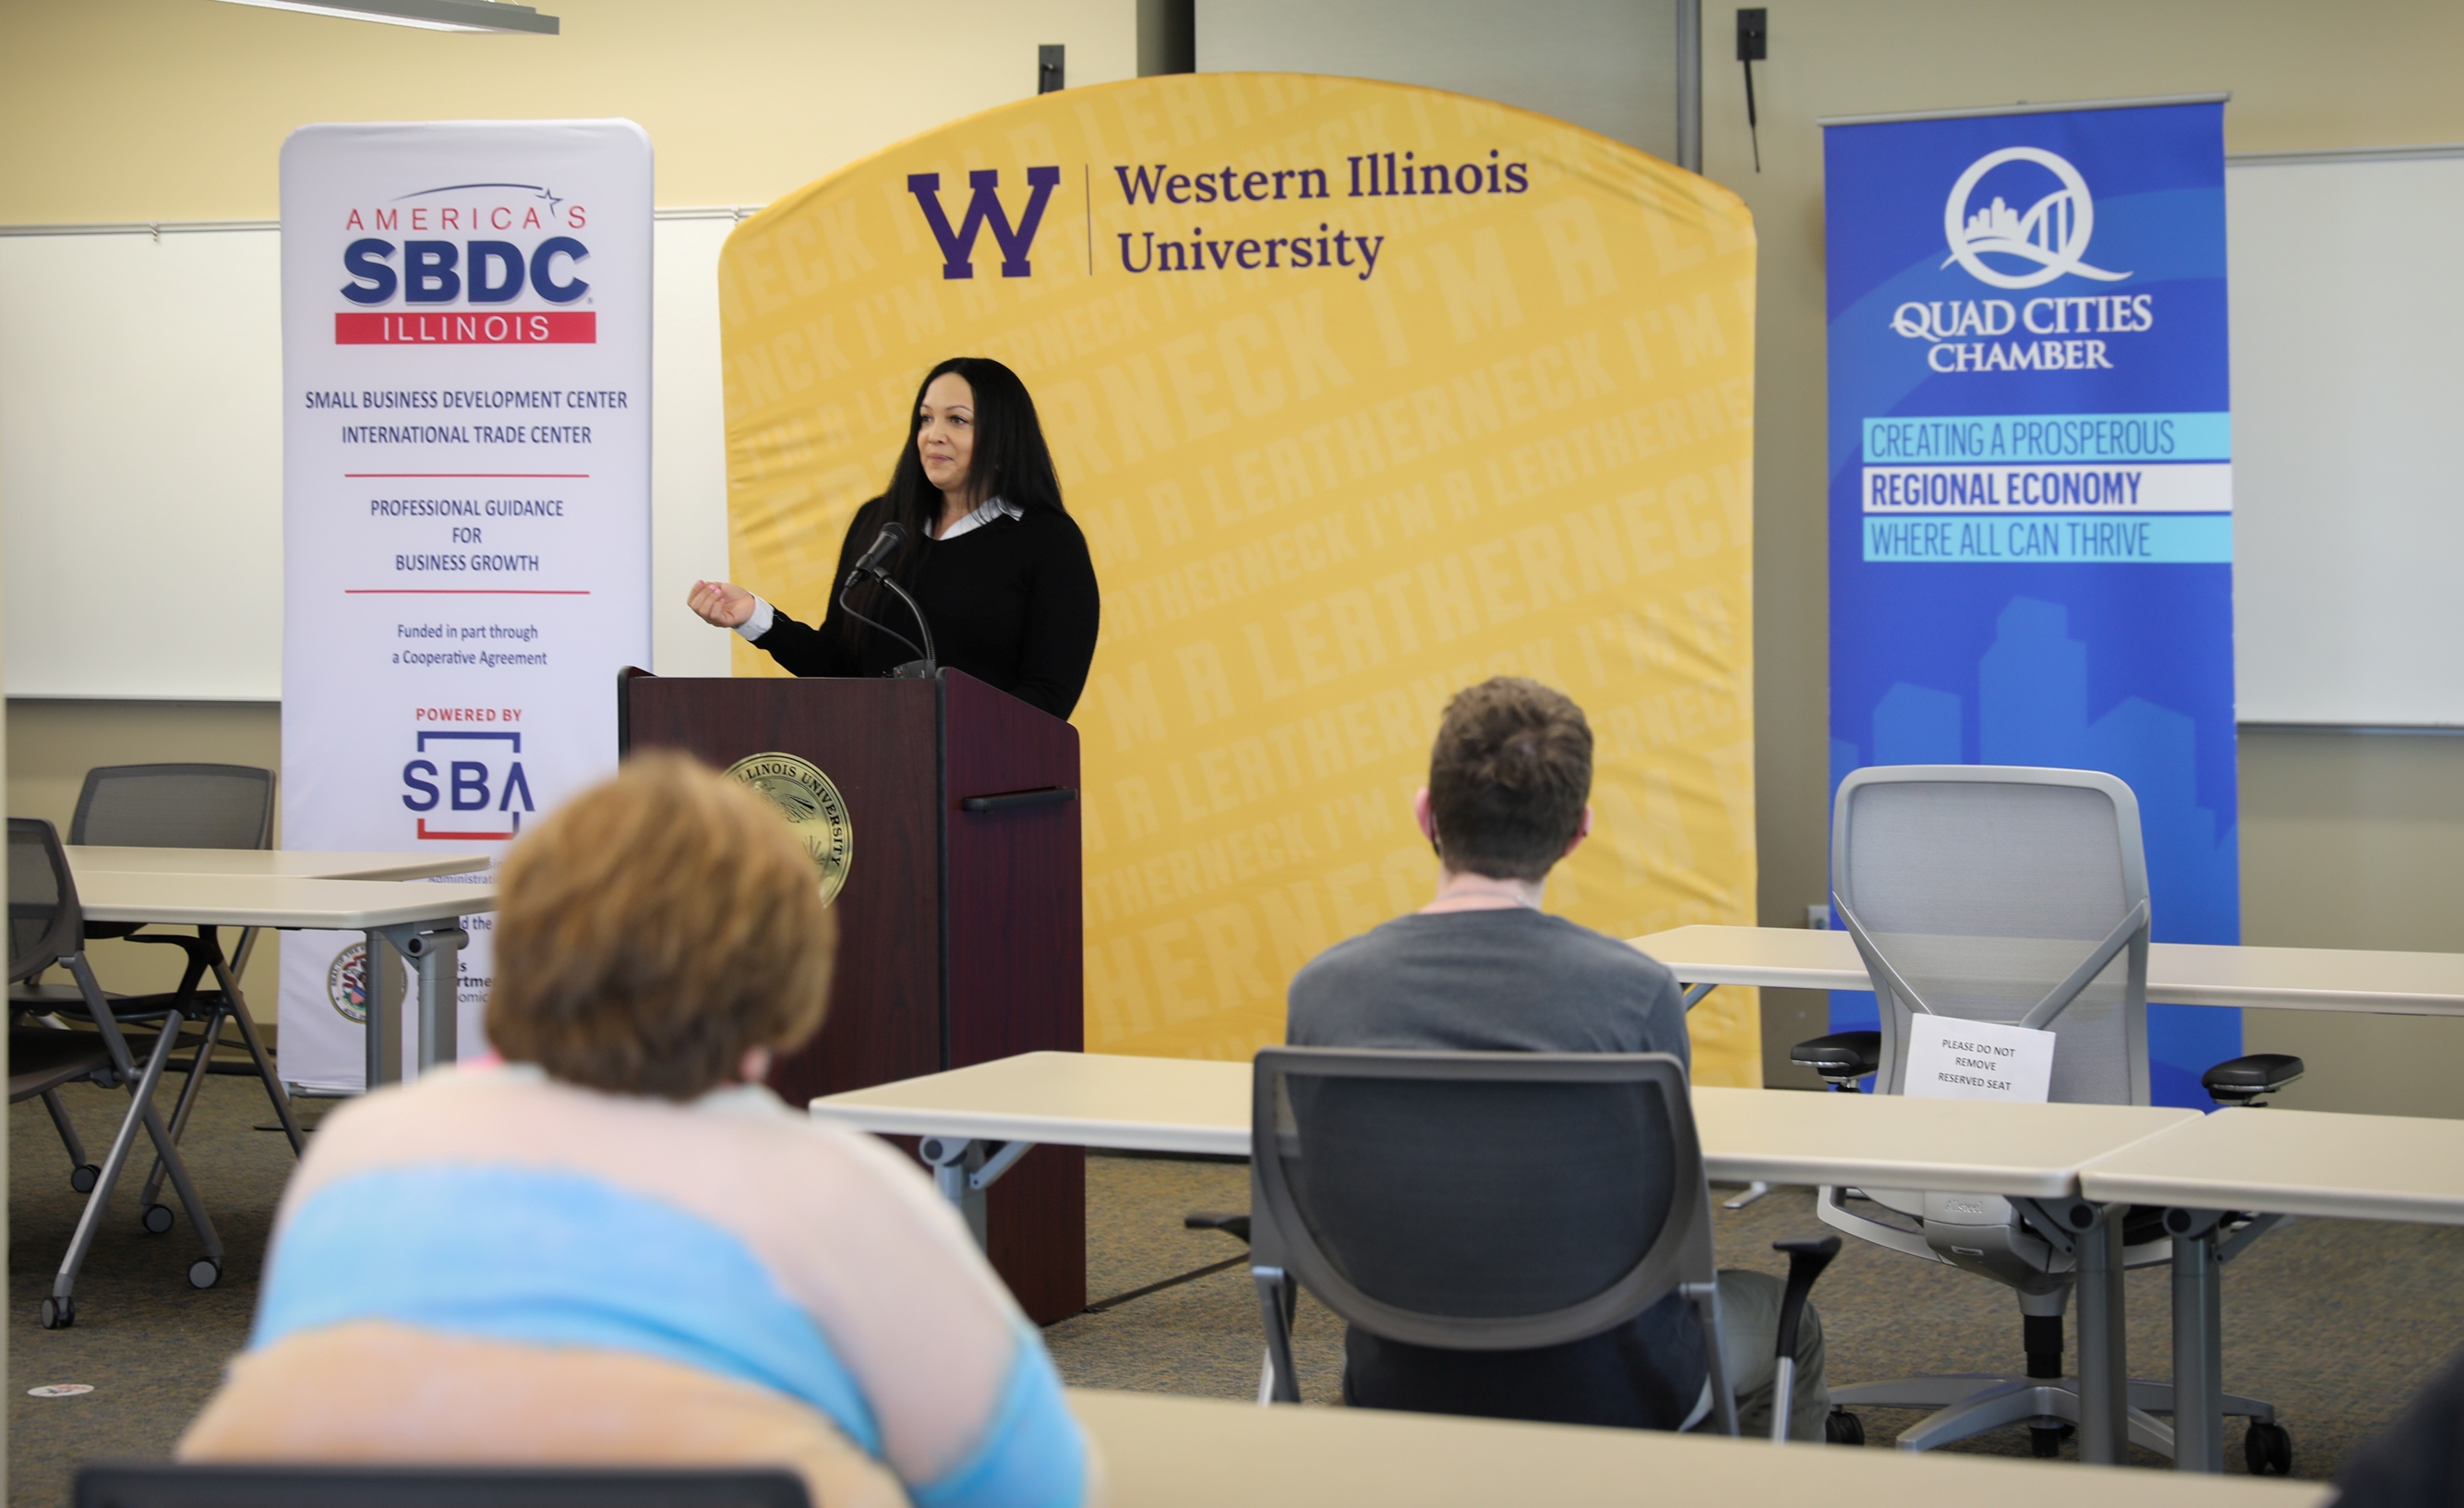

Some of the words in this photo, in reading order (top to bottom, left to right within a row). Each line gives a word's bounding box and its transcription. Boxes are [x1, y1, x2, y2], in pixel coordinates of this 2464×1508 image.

[1114, 163, 1328, 205] Western
[1347, 149, 1529, 198] Illinois
[907, 165, 1061, 280] W
[1118, 223, 1385, 281] University
[340, 235, 591, 306] SBDC
[382, 315, 551, 342] ILLINOIS
[1889, 299, 2017, 343] QUAD
[2022, 294, 2154, 334] CITIES
[1927, 339, 2114, 373] CHAMBER
[306, 391, 358, 409] SMALL
[363, 391, 439, 409] BUSINESS
[443, 391, 562, 408] DEVELOPMENT
[566, 391, 628, 408] CENTER
[343, 426, 470, 443] INTERNATIONAL
[474, 426, 526, 443] TRADE
[531, 426, 592, 443] CENTER
[1870, 423, 1984, 458] CREATING
[1990, 422, 2006, 456] A
[2013, 419, 2175, 456] PROSPEROUS
[1870, 473, 2001, 507] REGIONAL
[2006, 472, 2143, 506] ECONOMY
[371, 500, 481, 516] PROFESSIONAL
[486, 500, 563, 517] GUIDANCE
[452, 526, 482, 544] FOR
[1870, 523, 1953, 557] WHERE
[1959, 522, 2001, 557] ALL
[2008, 522, 2059, 557] CAN
[2065, 522, 2153, 558] THRIVE
[396, 554, 466, 571] BUSINESS
[471, 554, 539, 572] GROWTH
[397, 623, 443, 638] Funded
[446, 623, 458, 638] in
[461, 625, 487, 642] part
[488, 623, 538, 642] through
[392, 653, 400, 664] a
[403, 649, 476, 668] Cooperative
[479, 650, 547, 668] Agreement
[415, 707, 497, 721] POWERED
[502, 708, 522, 721] BY
[402, 759, 535, 813] SBA
[801, 772, 844, 867] UNIVERSITY
[1941, 1039, 1975, 1052] PLEASE
[1976, 1044, 1992, 1055] DO
[1993, 1046, 2016, 1057] NOT
[1955, 1056, 1997, 1071] REMOVE
[1938, 1072, 1985, 1087] RESERVED
[1986, 1079, 2012, 1091] SEAT
